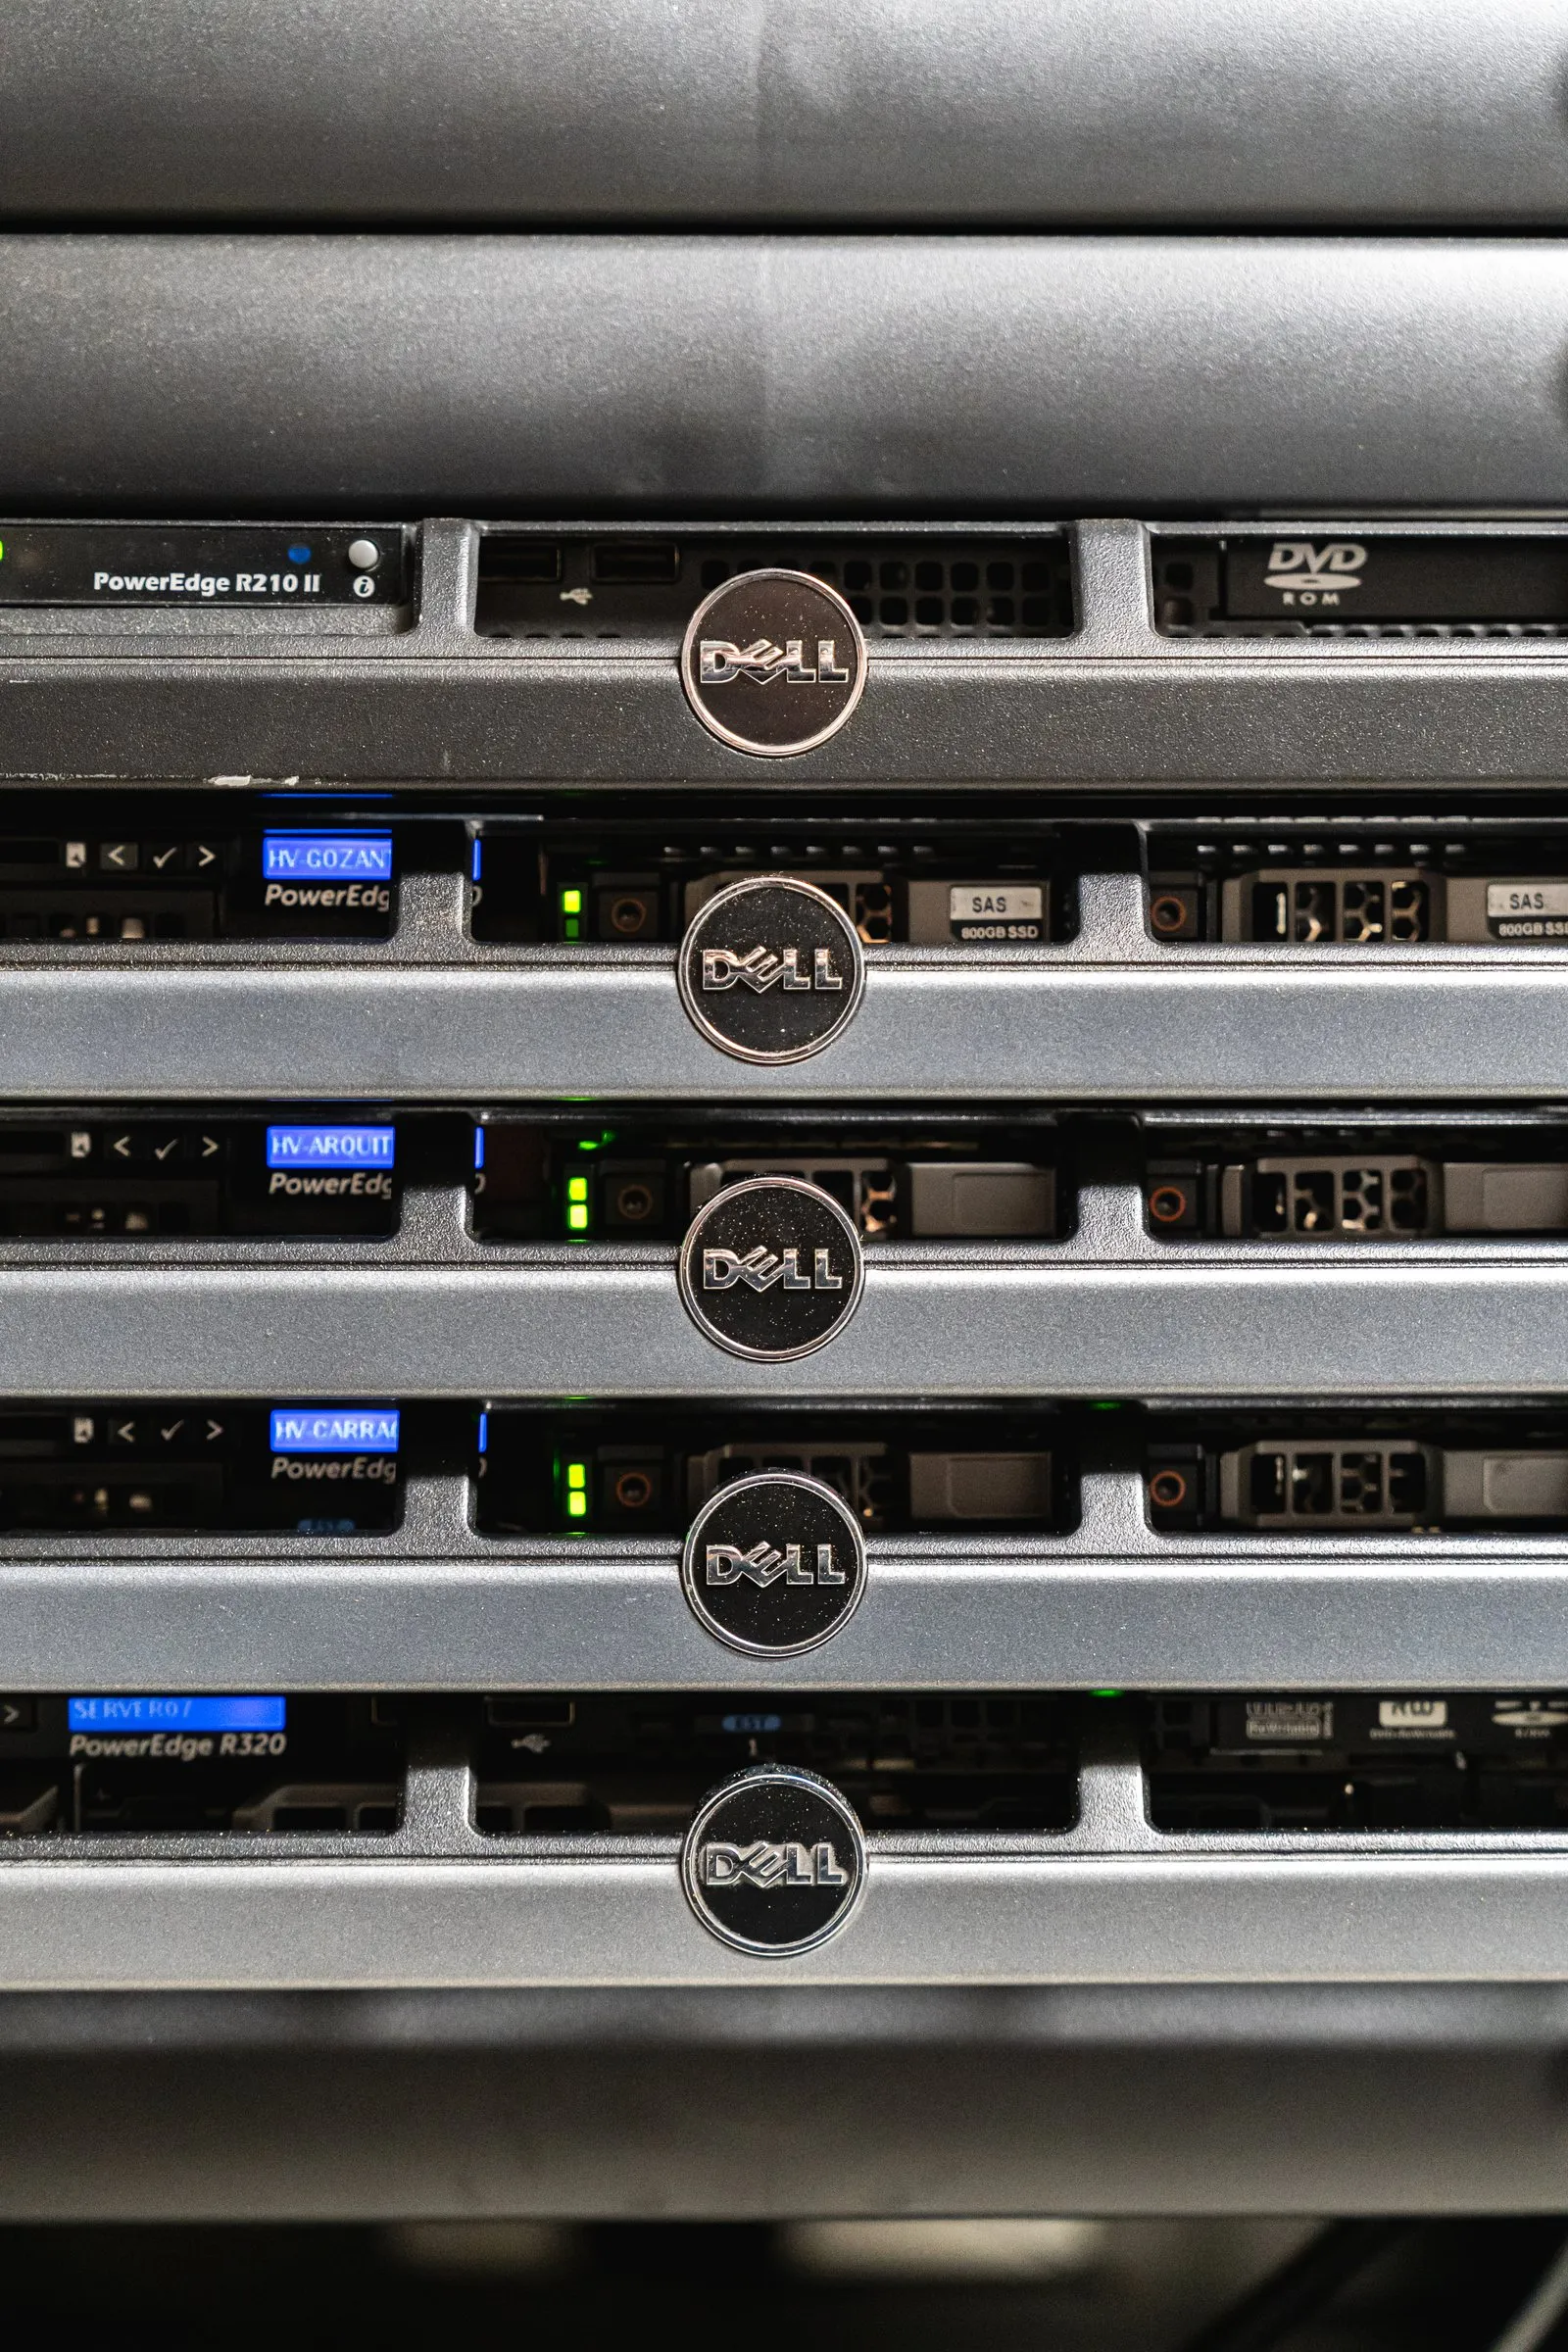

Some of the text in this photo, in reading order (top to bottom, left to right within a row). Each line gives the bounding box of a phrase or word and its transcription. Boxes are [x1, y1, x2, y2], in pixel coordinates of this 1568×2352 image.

[1267, 542, 1368, 573] DVD
[94, 572, 230, 597] PowerEdge
[235, 573, 298, 592] R210
[1282, 592, 1341, 606] ROM
[700, 639, 850, 684] DELL
[265, 884, 390, 912] PowerEdg
[971, 897, 1007, 913] SAS
[1509, 893, 1544, 909] SAS
[1007, 925, 1039, 940] SSD
[702, 946, 843, 994] DELL
[269, 1172, 392, 1200] PowerEdg
[703, 1246, 842, 1293] DELL
[270, 1456, 396, 1484] PowerEdg
[706, 1541, 846, 1588] DELL
[69, 1733, 287, 1761] PowerEdge R320
[705, 1842, 845, 1886] DELL
